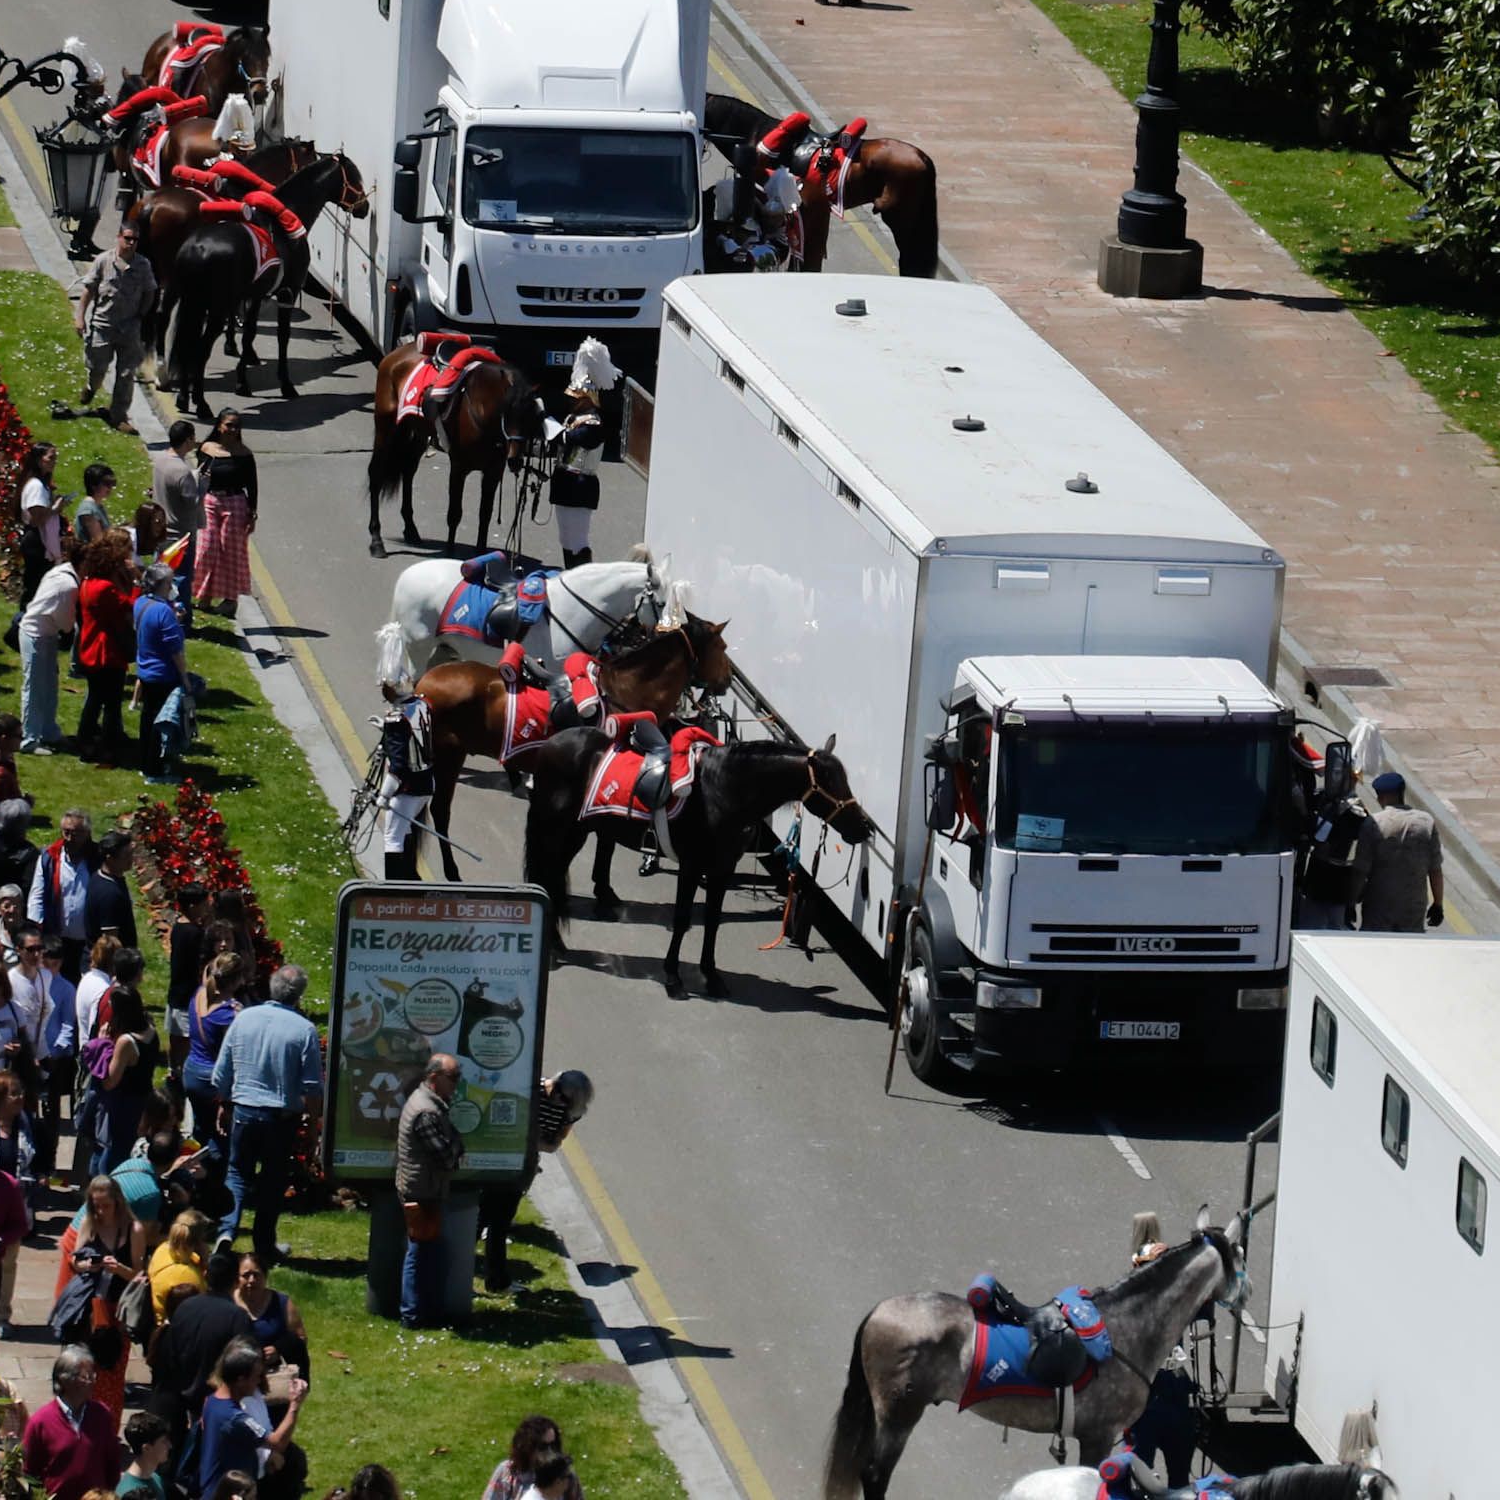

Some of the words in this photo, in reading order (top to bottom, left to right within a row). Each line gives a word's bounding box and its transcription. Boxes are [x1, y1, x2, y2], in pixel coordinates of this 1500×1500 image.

[512, 241, 646, 253] EUROCARGO
[543, 288, 620, 303] IVECO
[363, 902, 373, 914] A
[377, 902, 415, 917] partir
[419, 903, 437, 915] del
[444, 904, 451, 916] 1
[457, 905, 475, 917] DE
[479, 905, 525, 918] JUNIO
[1115, 938, 1176, 951] IVECO
[348, 961, 399, 973] Deposita
[401, 963, 427, 973] cada
[429, 964, 470, 974] residuo
[472, 966, 486, 974] en
[503, 966, 532, 976] color
[1108, 1023, 1124, 1037] ET
[1131, 1024, 1179, 1038] 104412
